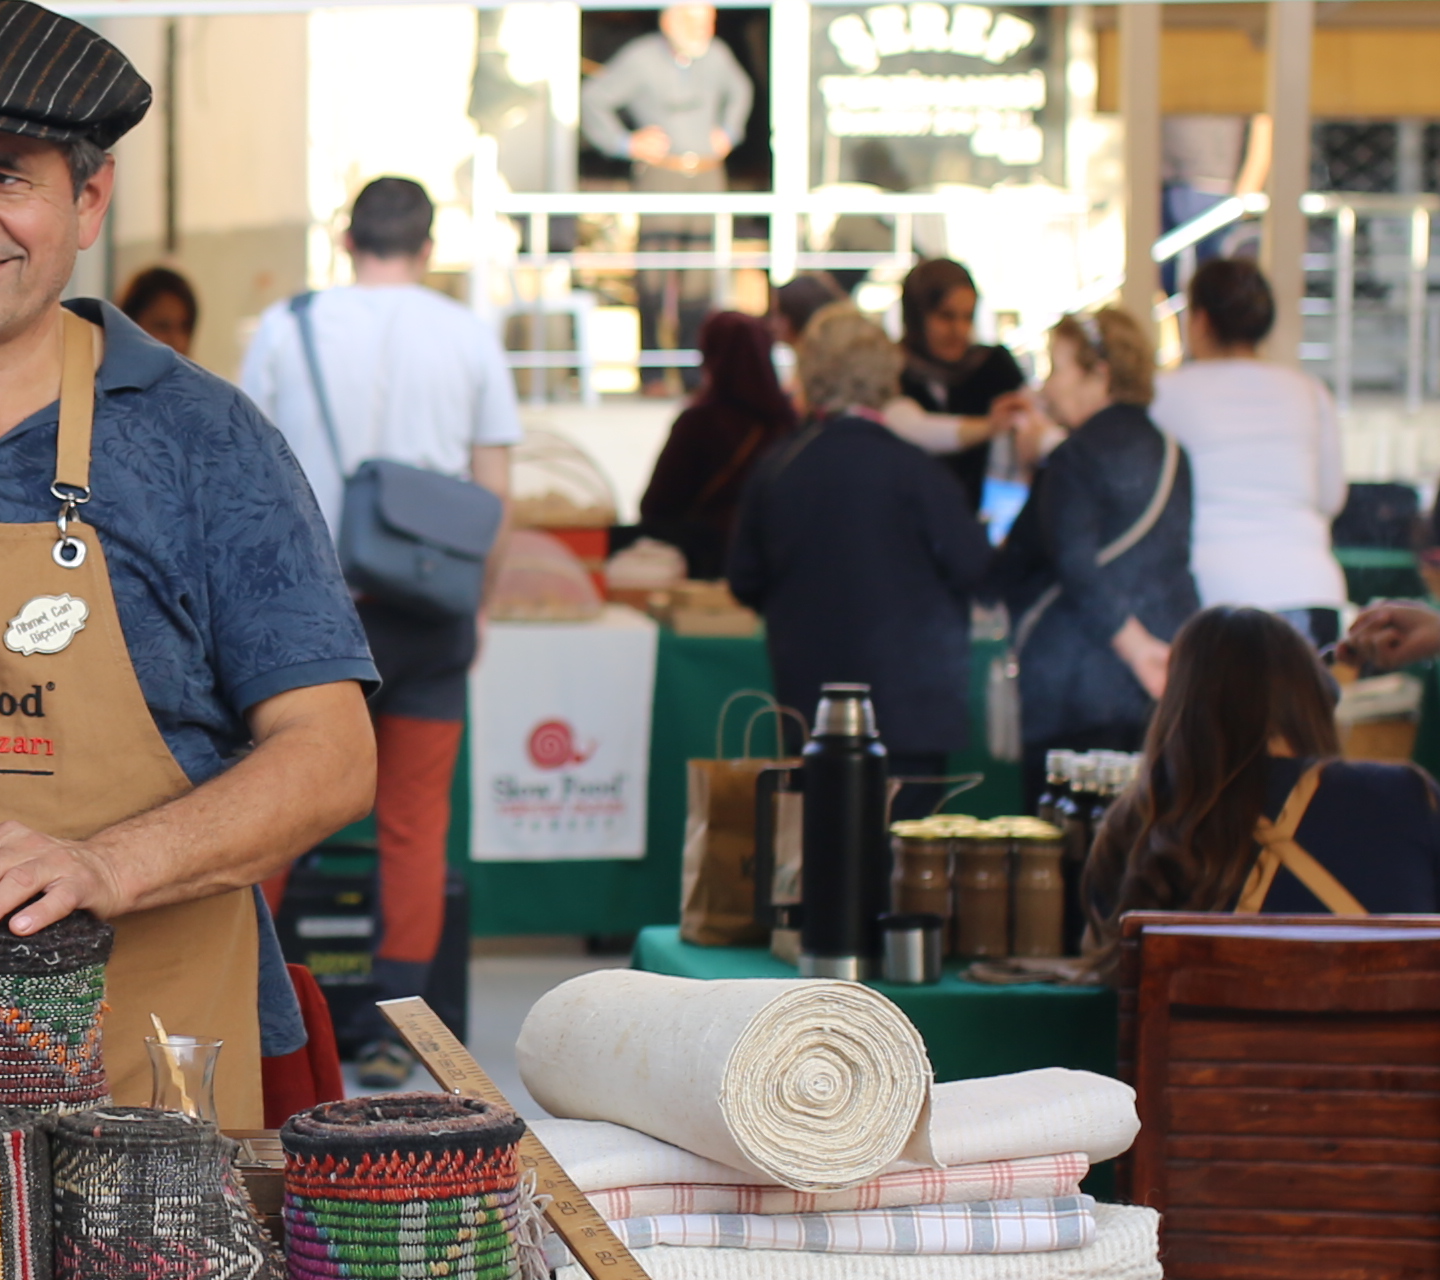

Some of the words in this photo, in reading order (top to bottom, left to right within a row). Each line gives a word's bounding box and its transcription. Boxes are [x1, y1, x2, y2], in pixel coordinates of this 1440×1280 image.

[447, 1067, 467, 1081] 20
[556, 1201, 578, 1216] 50
[595, 1250, 618, 1266] 60
